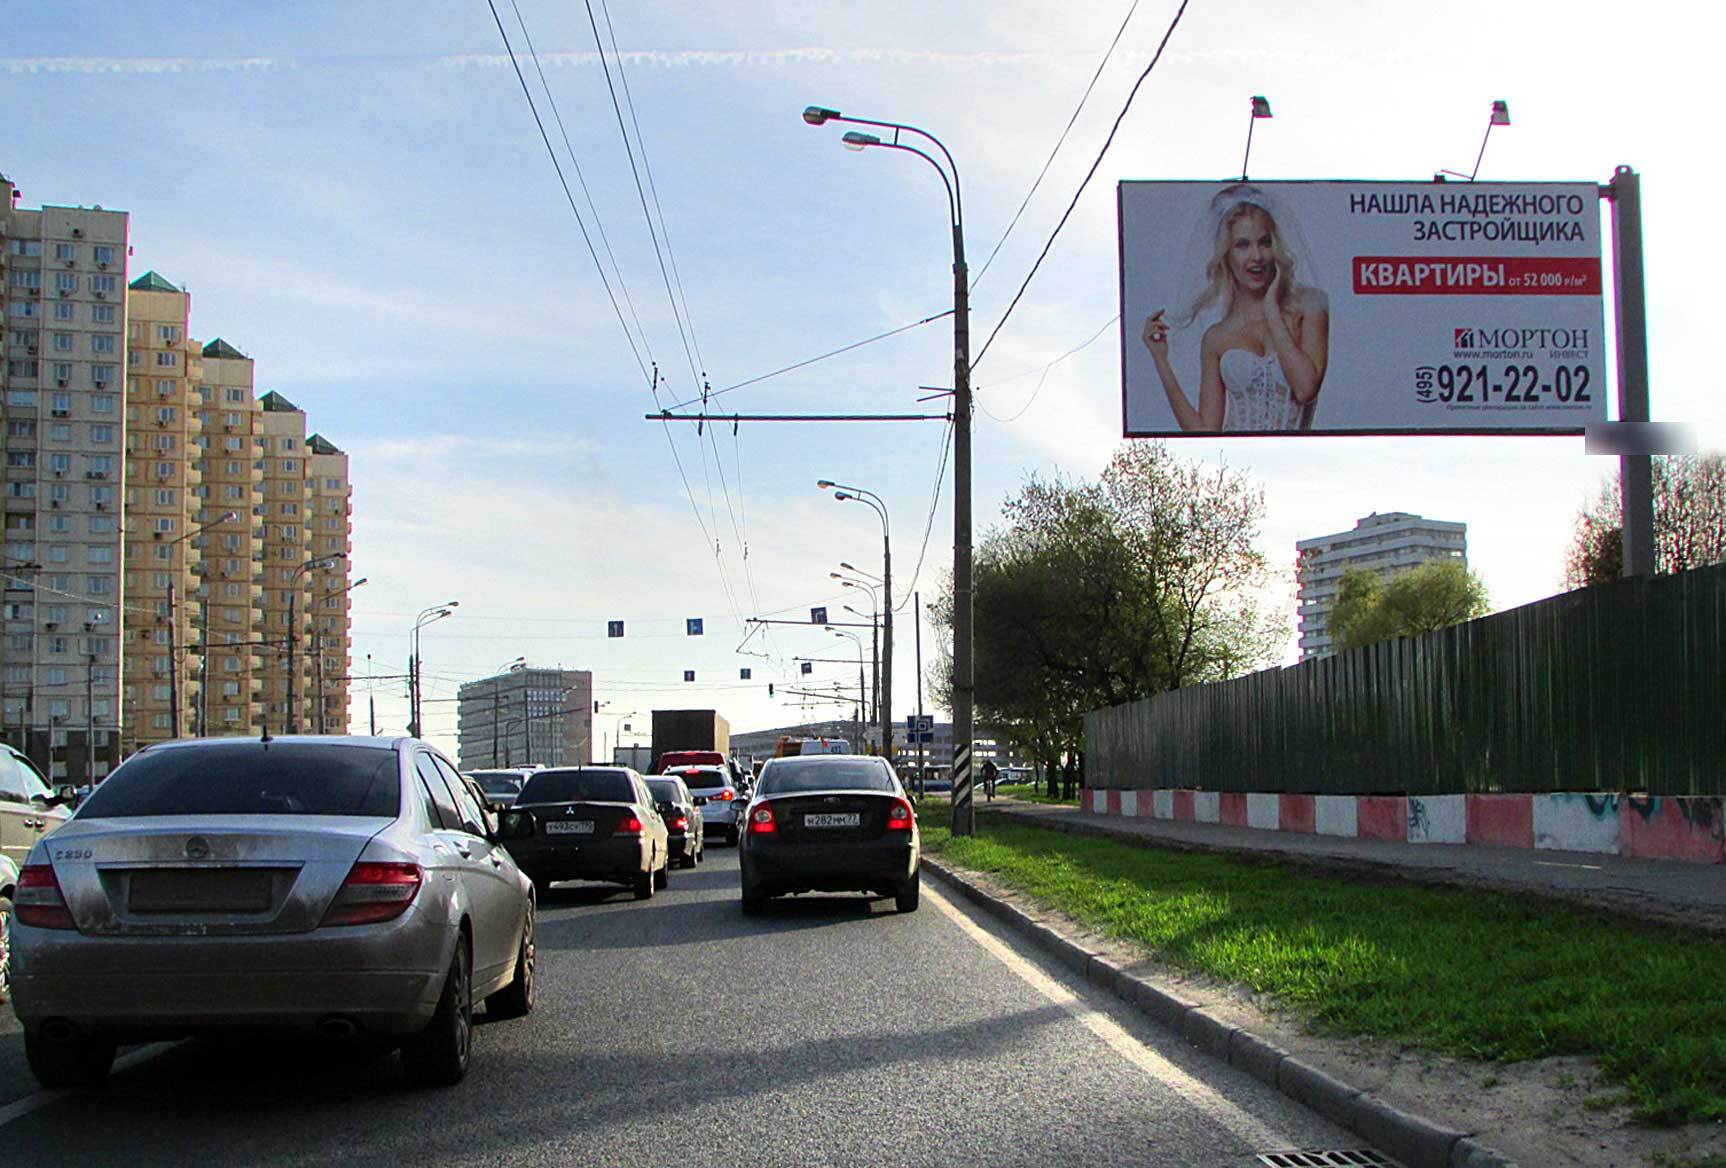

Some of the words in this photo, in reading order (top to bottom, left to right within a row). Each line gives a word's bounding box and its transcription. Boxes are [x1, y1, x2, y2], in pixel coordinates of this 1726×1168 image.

[1350, 194, 1435, 214] НАШЛА
[1441, 194, 1584, 217] НАДЕЖНОГО
[1413, 217, 1585, 245] ЗАСТРОЙЩИКА
[1360, 263, 1505, 287] КВАРТИРЫ
[1508, 277, 1521, 287] от
[1479, 328, 1588, 348] МОРТОН
[1454, 350, 1534, 359] www.morton.ru
[1416, 366, 1437, 403] (495)
[1437, 364, 1591, 402] 921-22-02
